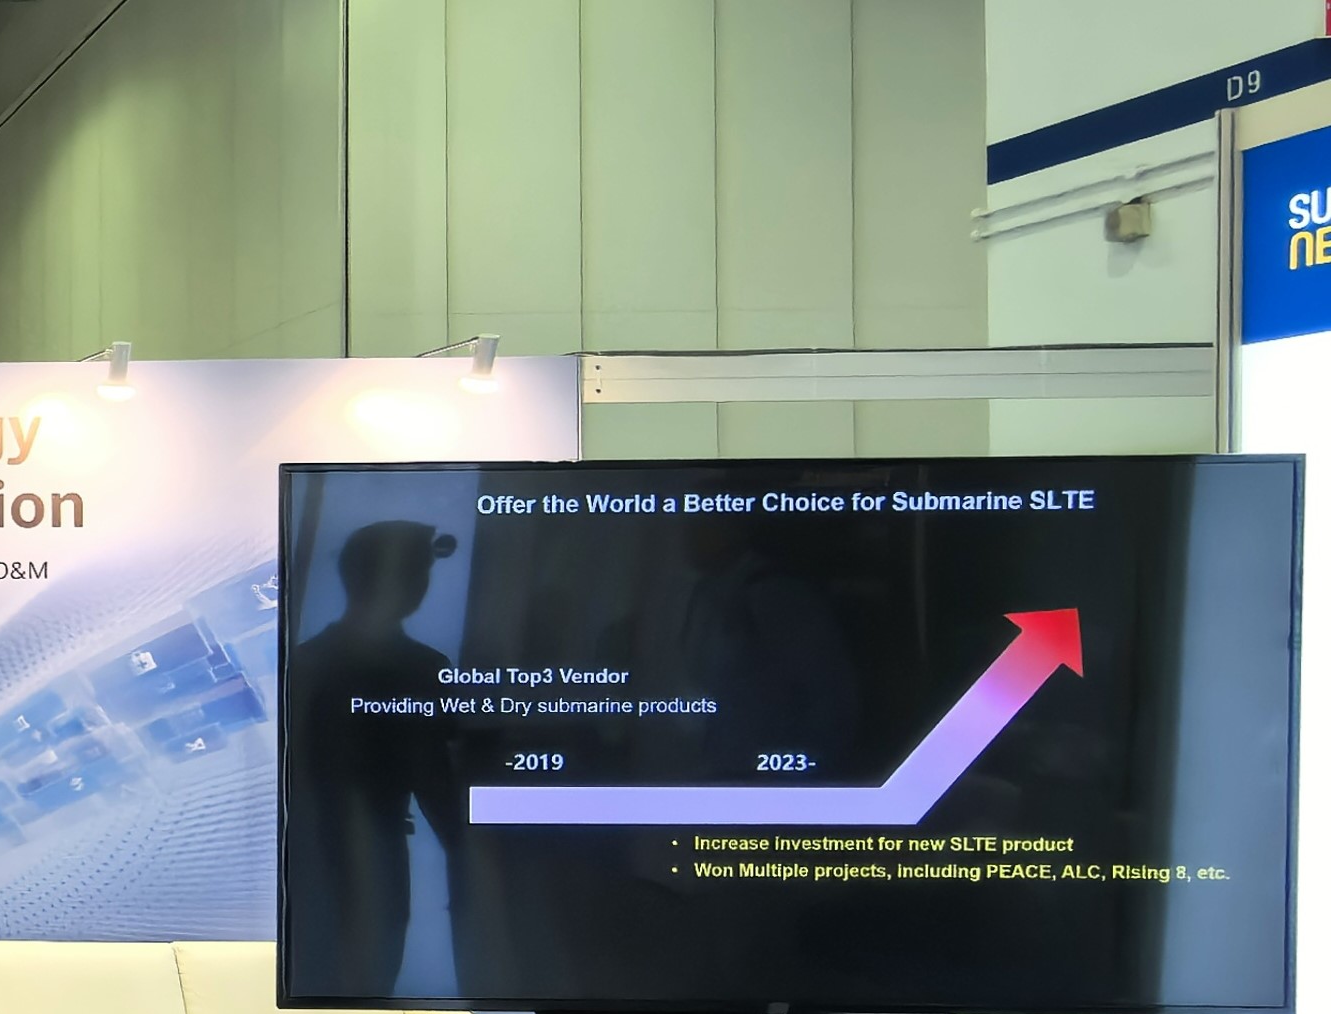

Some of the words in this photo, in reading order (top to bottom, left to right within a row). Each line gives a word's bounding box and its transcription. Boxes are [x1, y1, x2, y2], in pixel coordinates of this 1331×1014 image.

[1226, 70, 1262, 102] D9
[477, 495, 536, 515] Offer
[542, 494, 579, 514] the
[586, 494, 656, 514] World
[662, 498, 677, 514] a
[684, 493, 756, 514] Better
[762, 492, 845, 513] Choice
[852, 491, 886, 512] for
[892, 490, 1022, 512] Submarine
[1029, 490, 1095, 511] SLTE
[438, 668, 501, 685] Global
[507, 668, 554, 689] Top3
[559, 667, 629, 685] Vendor
[351, 698, 435, 717] Providing
[440, 698, 476, 714] Wet
[481, 698, 495, 714] &
[501, 698, 532, 717] Dry
[537, 697, 633, 714] submarine
[638, 698, 717, 717] products
[505, 754, 564, 772] -2019
[756, 754, 816, 772] 2023-
[694, 835, 770, 851] Increase
[775, 835, 873, 852] investment
[878, 836, 904, 852] for
[908, 839, 945, 852] new
[950, 836, 997, 852] SLTE
[1002, 836, 1074, 856] product
[694, 863, 734, 878] Won
[738, 862, 809, 881] Multiple
[814, 863, 892, 882] projects,
[897, 863, 981, 882] including
[986, 864, 1057, 881] PEACE,
[1061, 864, 1106, 882] ALC,
[1112, 864, 1171, 883] Rising
[1176, 865, 1191, 882] 8,
[1197, 866, 1230, 882] etc.
